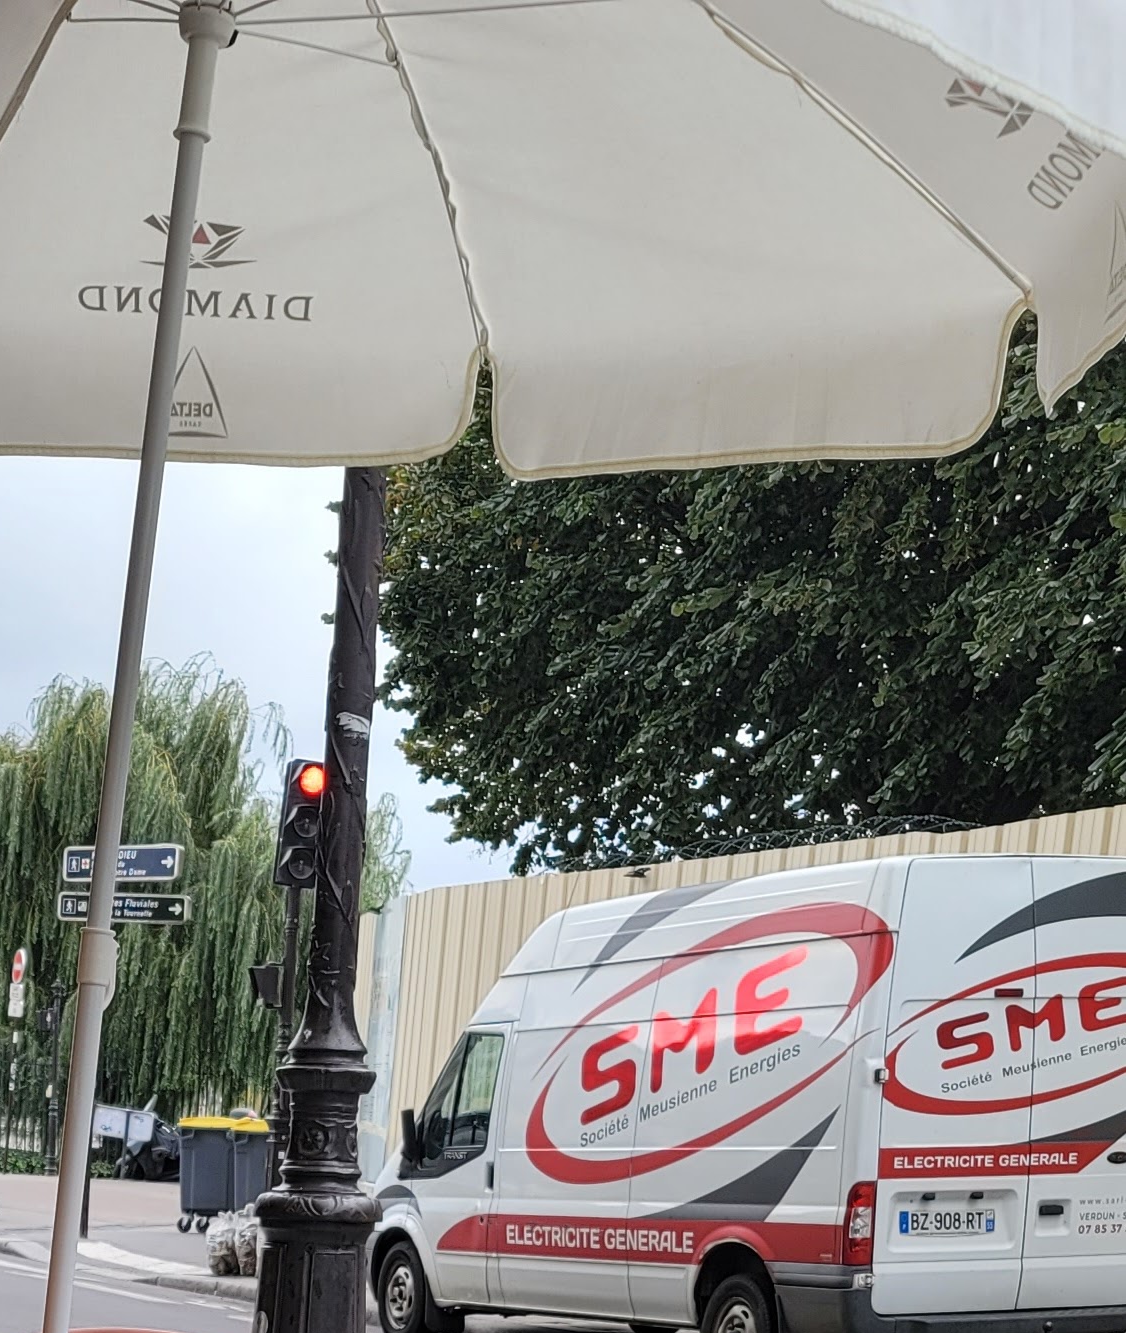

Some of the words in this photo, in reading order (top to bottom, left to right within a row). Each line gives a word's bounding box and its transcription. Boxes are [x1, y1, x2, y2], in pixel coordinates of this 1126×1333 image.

[124, 898, 159, 909] Fluviales
[580, 944, 809, 1126] SME
[936, 976, 1126, 1070] SME
[941, 1072, 993, 1093] Société
[1002, 1051, 1072, 1079] Meusienne
[580, 1114, 629, 1148] Société
[639, 1079, 718, 1123] Meusienne
[729, 1044, 802, 1084] Energies
[893, 1155, 995, 1169] ELECTRICITE
[998, 1152, 1079, 1168] GENERALE
[911, 1212, 984, 1231] BZ-908-RT
[1078, 1224, 1092, 1234] 07
[1094, 1224, 1107, 1234] 85
[1110, 1223, 1123, 1233] 37
[1079, 1212, 1115, 1221] VERDUN
[506, 1224, 600, 1249] ELECTRICITE
[604, 1228, 694, 1254] GENERALE
